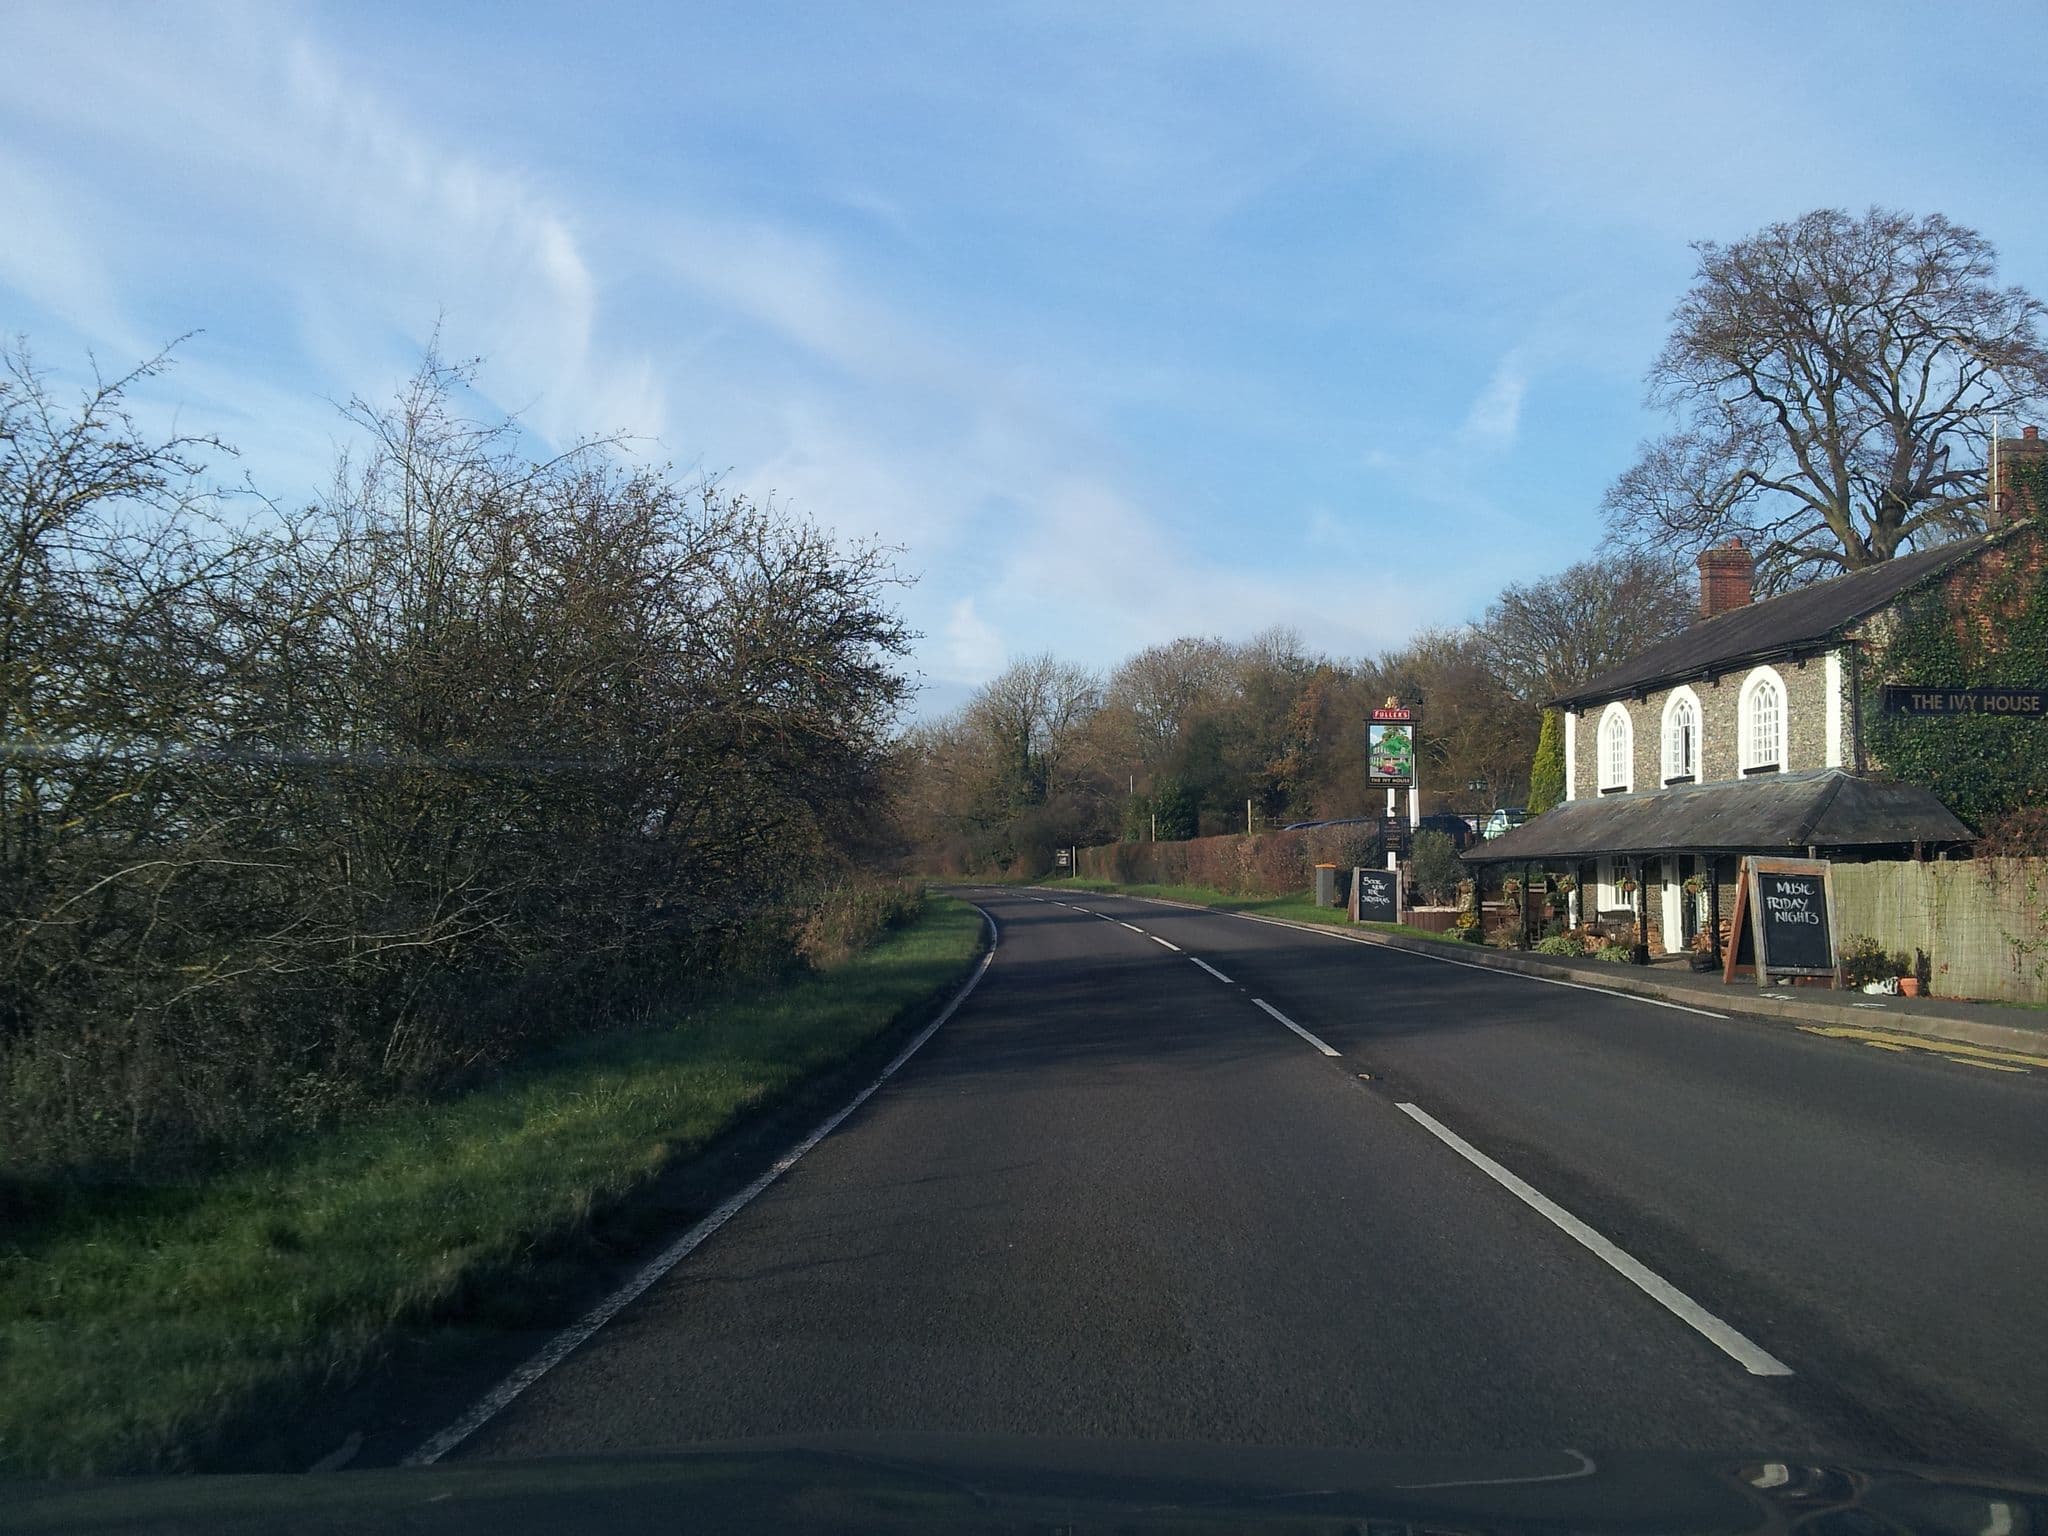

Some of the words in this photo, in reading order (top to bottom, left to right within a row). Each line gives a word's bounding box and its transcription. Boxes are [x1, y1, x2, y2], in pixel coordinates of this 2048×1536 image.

[1912, 694, 1943, 709] THE
[1949, 695, 1977, 710] IVY
[1984, 696, 2041, 711] HOUSE
[1776, 881, 1815, 895] MUSIC
[1766, 896, 1808, 910] FRIDAY
[1775, 911, 1819, 924] NIGHTS
